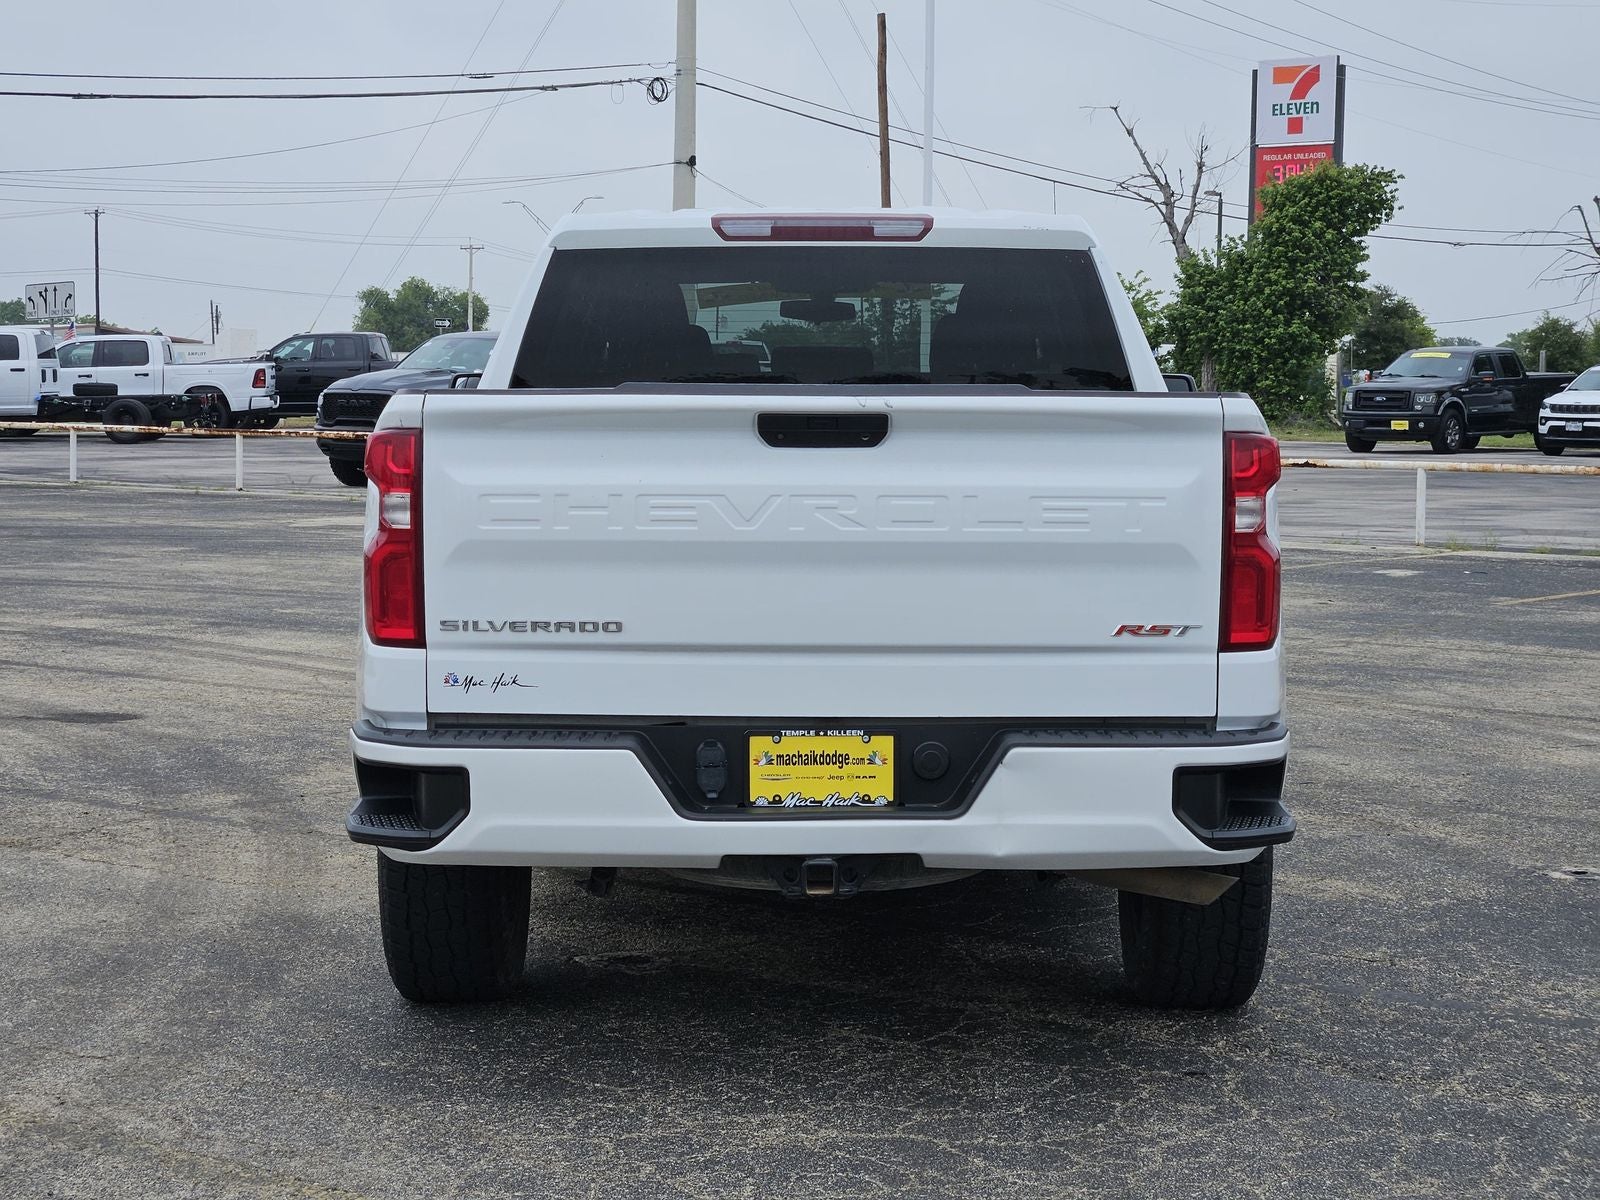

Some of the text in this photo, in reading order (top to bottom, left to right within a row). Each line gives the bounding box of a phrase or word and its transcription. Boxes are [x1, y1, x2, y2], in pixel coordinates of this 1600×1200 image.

[1262, 152, 1326, 161] REGULAR UNLEADED
[477, 493, 1167, 533] CHEVROLET
[439, 619, 623, 633] SILVERADO
[1111, 624, 1203, 637] RST
[461, 672, 539, 694] Mac Haik
[827, 729, 864, 737] KILLEEN
[775, 750, 866, 769] machaikdodge.com
[782, 791, 864, 808] Mac Haik
